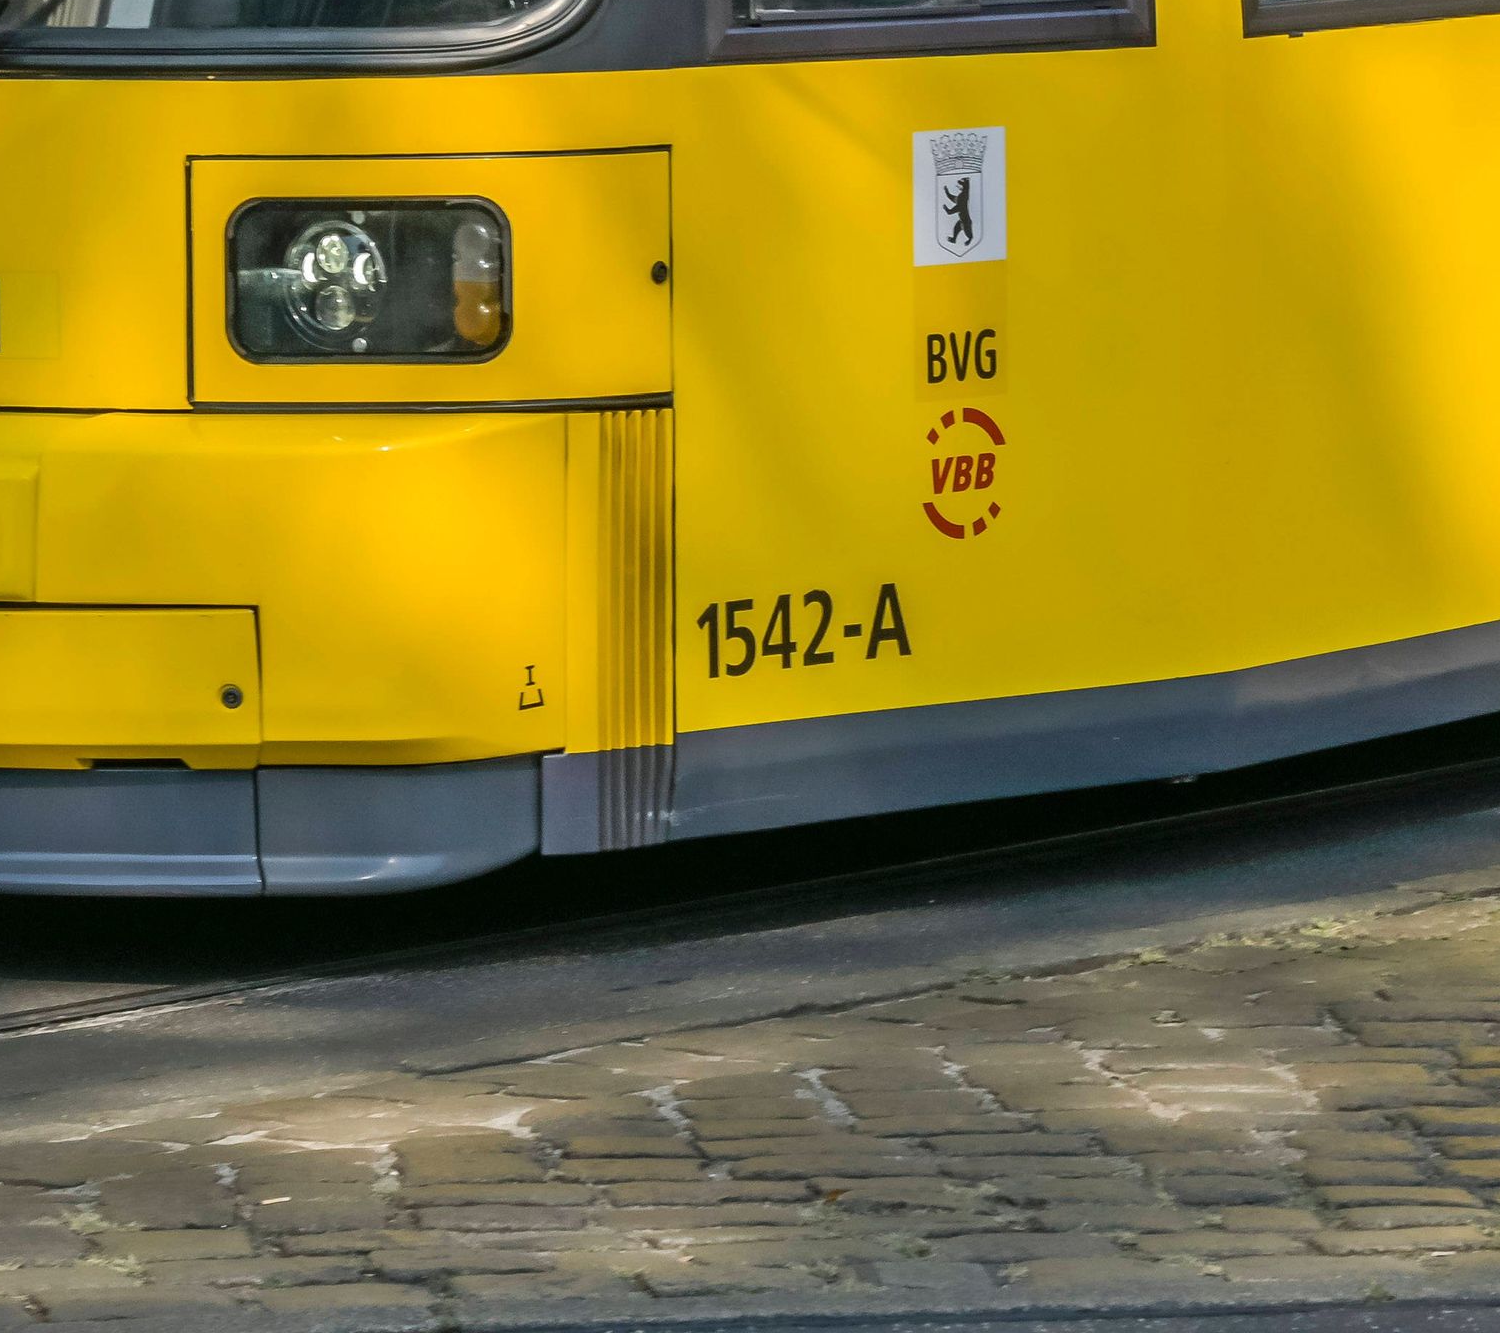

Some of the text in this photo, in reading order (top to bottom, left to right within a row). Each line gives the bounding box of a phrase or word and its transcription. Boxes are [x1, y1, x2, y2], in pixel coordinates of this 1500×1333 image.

[926, 328, 998, 385] BVG
[930, 452, 996, 495] VBB
[696, 582, 913, 679] 1542-A
